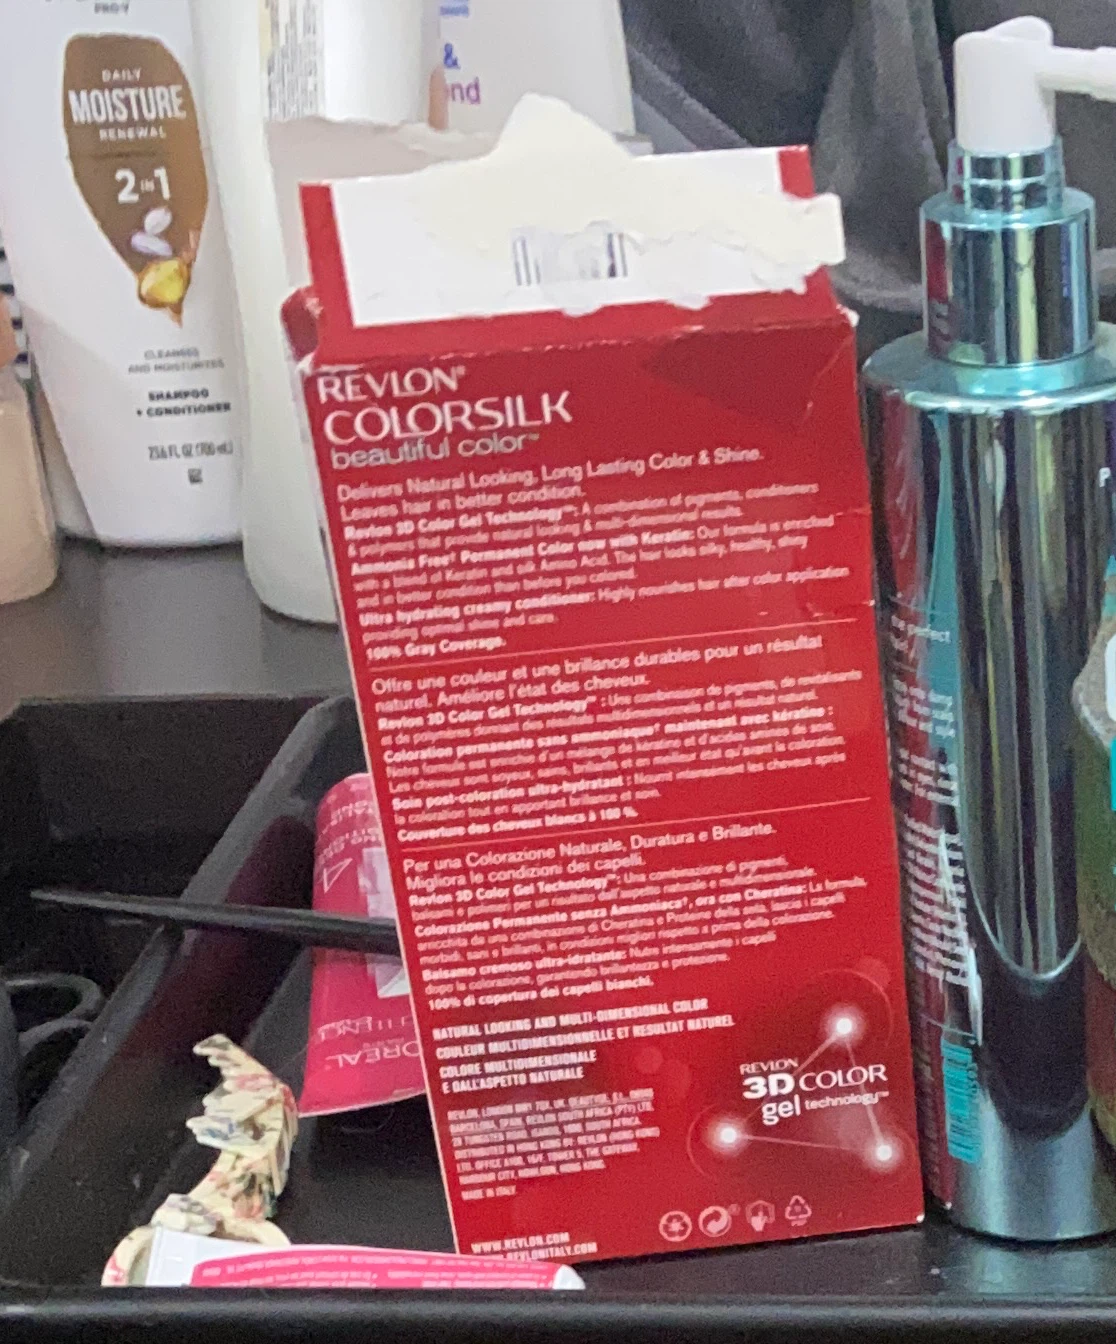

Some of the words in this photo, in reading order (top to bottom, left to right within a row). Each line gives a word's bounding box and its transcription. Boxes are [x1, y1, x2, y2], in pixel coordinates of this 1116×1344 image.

[102, 67, 142, 83] DAILY
[68, 84, 187, 125] MOISTURE
[99, 125, 167, 141] RENEWAL
[114, 167, 140, 205] 2
[154, 166, 171, 201] 1
[147, 402, 231, 417] CONDITIONER
[148, 388, 210, 401] SHAMPOO
[321, 387, 571, 446] COLORSILK
[329, 435, 450, 470] beautiful
[336, 478, 403, 502] Delivers
[405, 472, 465, 494] Natural
[468, 465, 538, 490] Looking,
[540, 461, 583, 483] Long
[585, 455, 645, 478] Lasting
[647, 449, 693, 470] Color
[697, 449, 709, 465] &
[713, 444, 760, 464] Shine.
[402, 856, 429, 873] Per
[433, 857, 462, 870] una
[464, 844, 556, 867] Colorazione
[558, 837, 626, 857] Naturale,
[629, 829, 694, 849] Duratura
[697, 831, 708, 841] e
[711, 820, 774, 840] Brillante.
[740, 1058, 799, 1076] REVLON
[743, 1073, 795, 1100] 3D
[799, 1064, 888, 1092] COLOR
[761, 1094, 802, 1126] gel
[506, 1241, 598, 1260] REVLONITALY.COM
